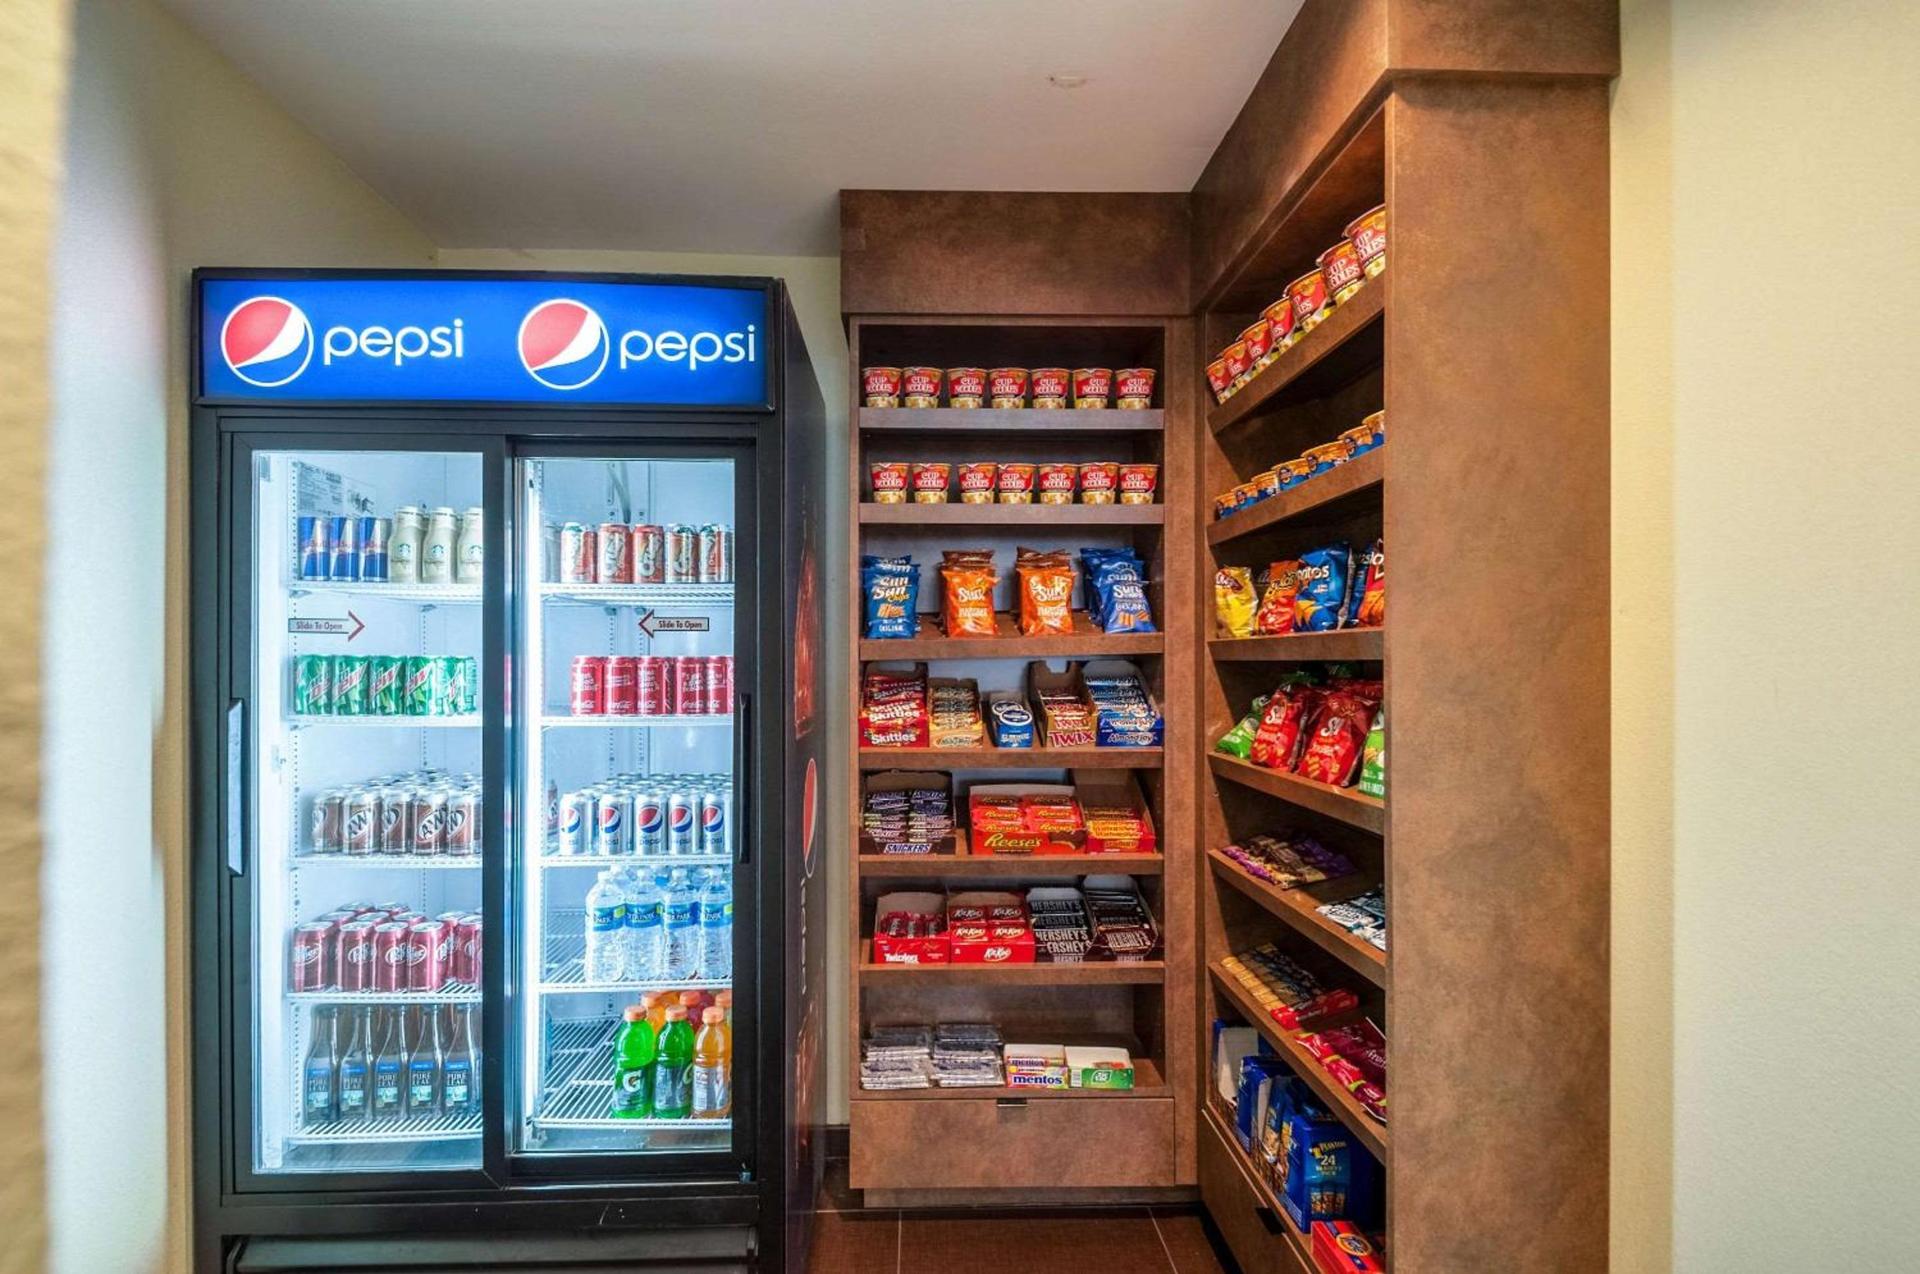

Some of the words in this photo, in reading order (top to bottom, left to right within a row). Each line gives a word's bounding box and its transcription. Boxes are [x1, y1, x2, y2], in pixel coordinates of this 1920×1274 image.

[323, 318, 464, 366] pepsi
[620, 324, 755, 371] pepsi
[296, 620, 313, 630] Slide
[314, 620, 322, 630] To
[324, 620, 343, 631] Open
[658, 620, 674, 628] Slide
[676, 620, 684, 628] To
[685, 620, 702, 630] Open
[871, 732, 916, 745] Skittles
[984, 832, 1042, 848] Reese's
[884, 843, 930, 853] SNICKERS
[1036, 930, 1088, 941] HERSHEY'S
[1047, 940, 1092, 954] ERSHEY'S
[623, 1070, 642, 1092] G
[1014, 1075, 1062, 1084] mentos
[1320, 1154, 1336, 1166] 24
